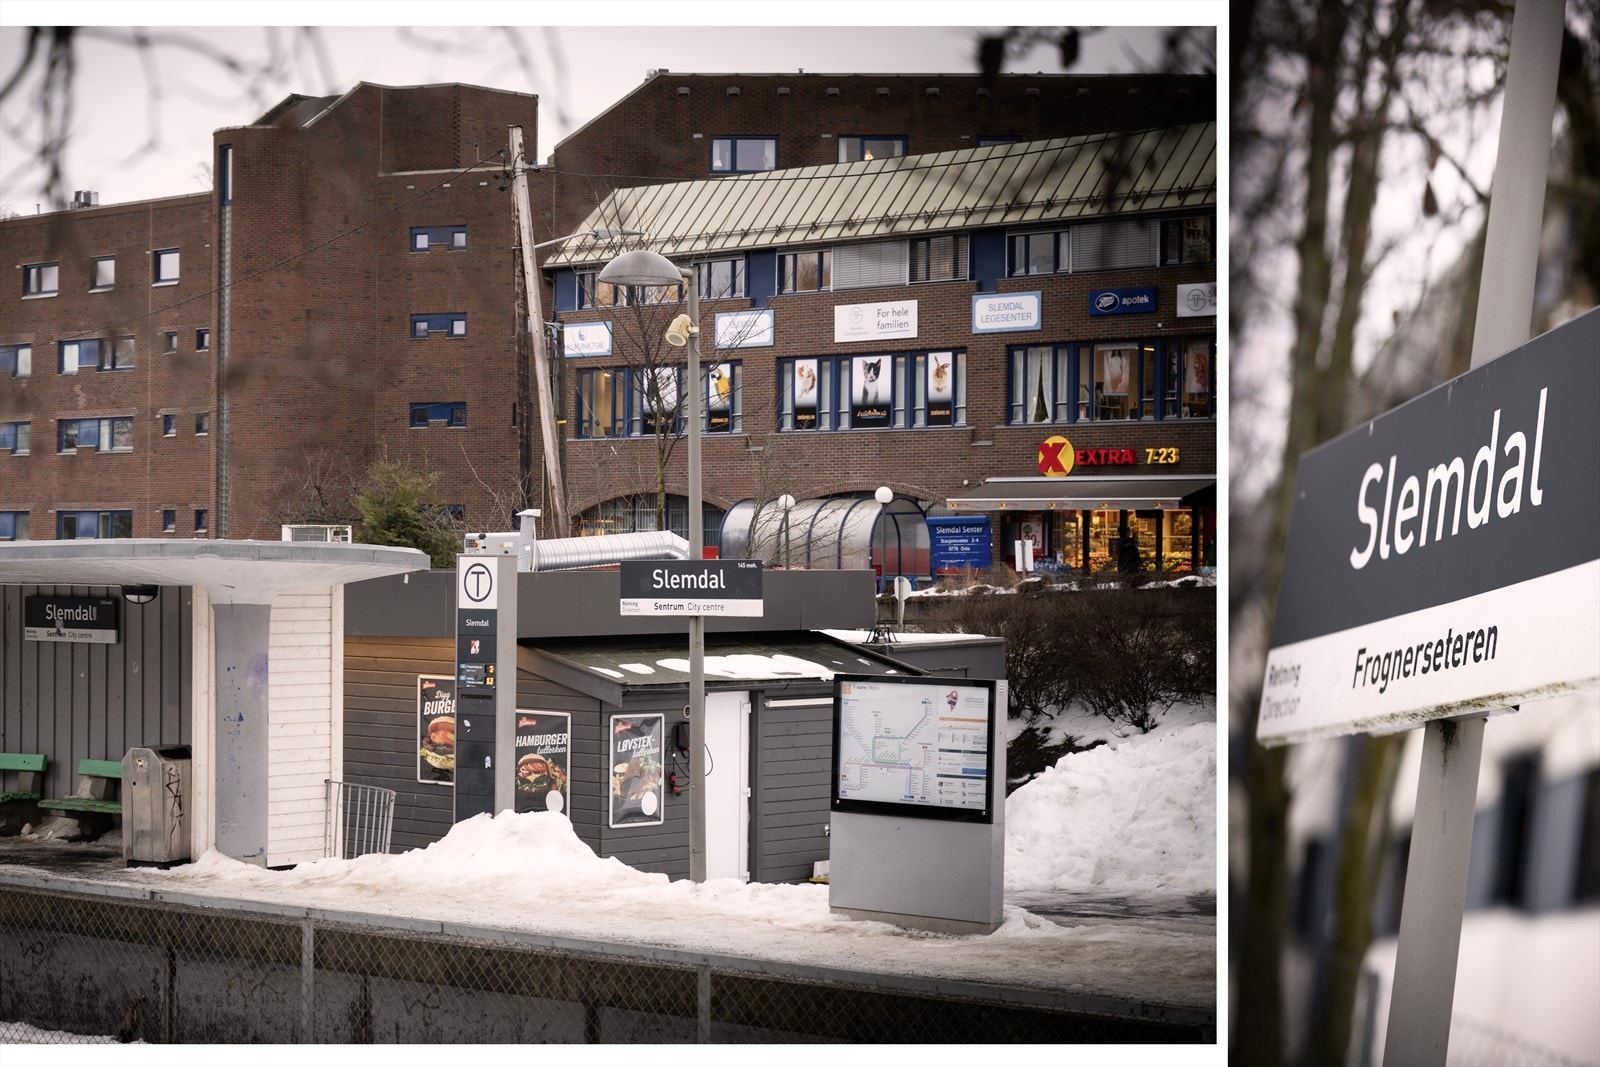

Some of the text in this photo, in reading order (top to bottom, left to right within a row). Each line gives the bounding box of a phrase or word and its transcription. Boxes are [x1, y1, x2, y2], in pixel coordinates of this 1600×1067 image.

[1122, 294, 1150, 306] apotek
[877, 306, 909, 318] For hele
[988, 302, 1025, 312] SLEMDAL
[980, 312, 1032, 323] LEGESENTER
[877, 319, 909, 330] familien
[1075, 449, 1136, 466] EXTRA
[1145, 447, 1179, 464] 7-23
[1350, 386, 1548, 570] Slemdal
[936, 526, 983, 534] Slemdal Senter
[652, 569, 726, 589] Slemdal
[45, 604, 93, 621] Slemdal
[654, 602, 725, 613] Sentrum City centre
[466, 618, 490, 627] Slemdal
[68, 631, 77, 640] City
[1352, 624, 1499, 695] Frognerseteren
[1268, 660, 1301, 688] Retning
[515, 733, 568, 747] HAMBURGER
